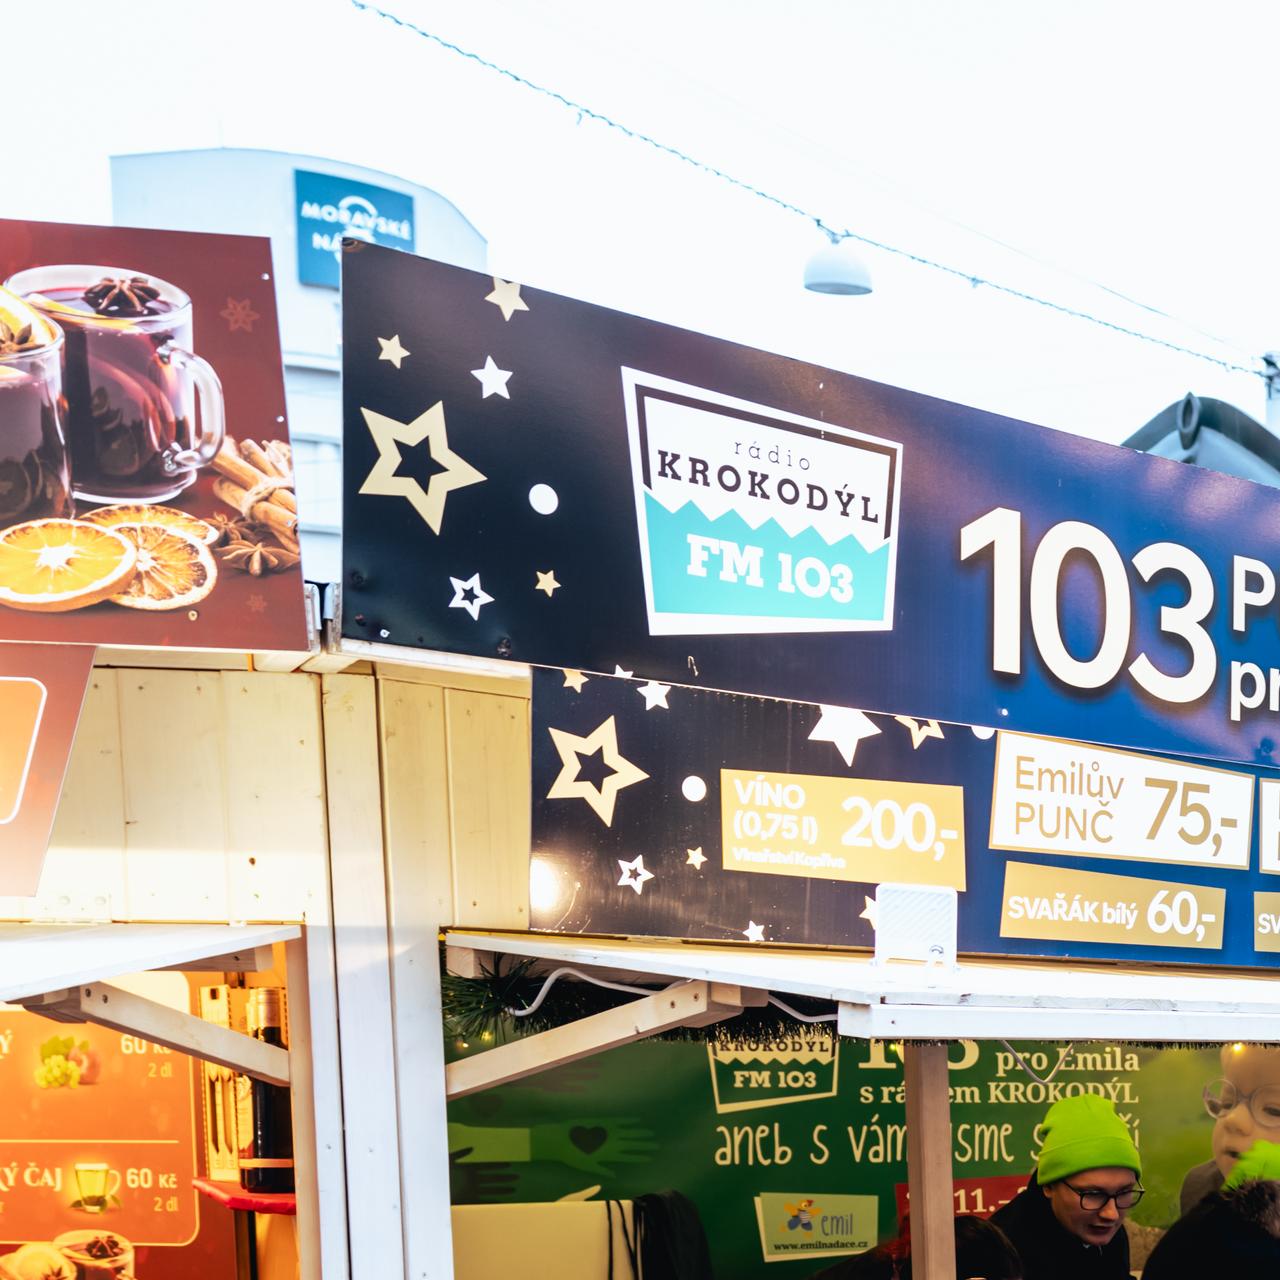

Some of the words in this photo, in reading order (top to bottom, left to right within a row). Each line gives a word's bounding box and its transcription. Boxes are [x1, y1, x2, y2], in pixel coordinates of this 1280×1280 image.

[300, 201, 412, 240] MORAVSKÉ
[734, 440, 810, 471] rádio
[657, 449, 879, 524] KROKODÝL
[686, 533, 764, 588] FM
[778, 552, 854, 604] 103
[960, 507, 1217, 703] 103
[734, 775, 805, 809] VÍNO
[1015, 756, 1125, 799] Emilův
[841, 796, 958, 861] 200,-
[1015, 801, 1114, 843] PUNČ
[1144, 777, 1237, 857] 75,-
[1008, 893, 1098, 923] SVAŘÁK
[1102, 901, 1138, 931] bílý
[1147, 890, 1216, 942] 60,-
[120, 1034, 146, 1055] 60
[148, 1063, 157, 1077] 2
[160, 1063, 173, 1077] dl
[996, 1050, 1048, 1076] pro
[1057, 1047, 1140, 1071] Emila
[734, 1070, 771, 1088] FM
[778, 1071, 816, 1088] 103
[860, 1085, 874, 1103] s
[715, 1122, 793, 1166] aneb
[810, 1123, 829, 1164] s
[24, 1162, 62, 1190] ČAJ
[126, 1168, 152, 1188] 60
[159, 1173, 178, 1188] Kč
[154, 1197, 163, 1211] 2
[166, 1197, 178, 1211] dl
[821, 1213, 853, 1236] emil
[774, 1240, 868, 1251] www.emilnadace.cz
